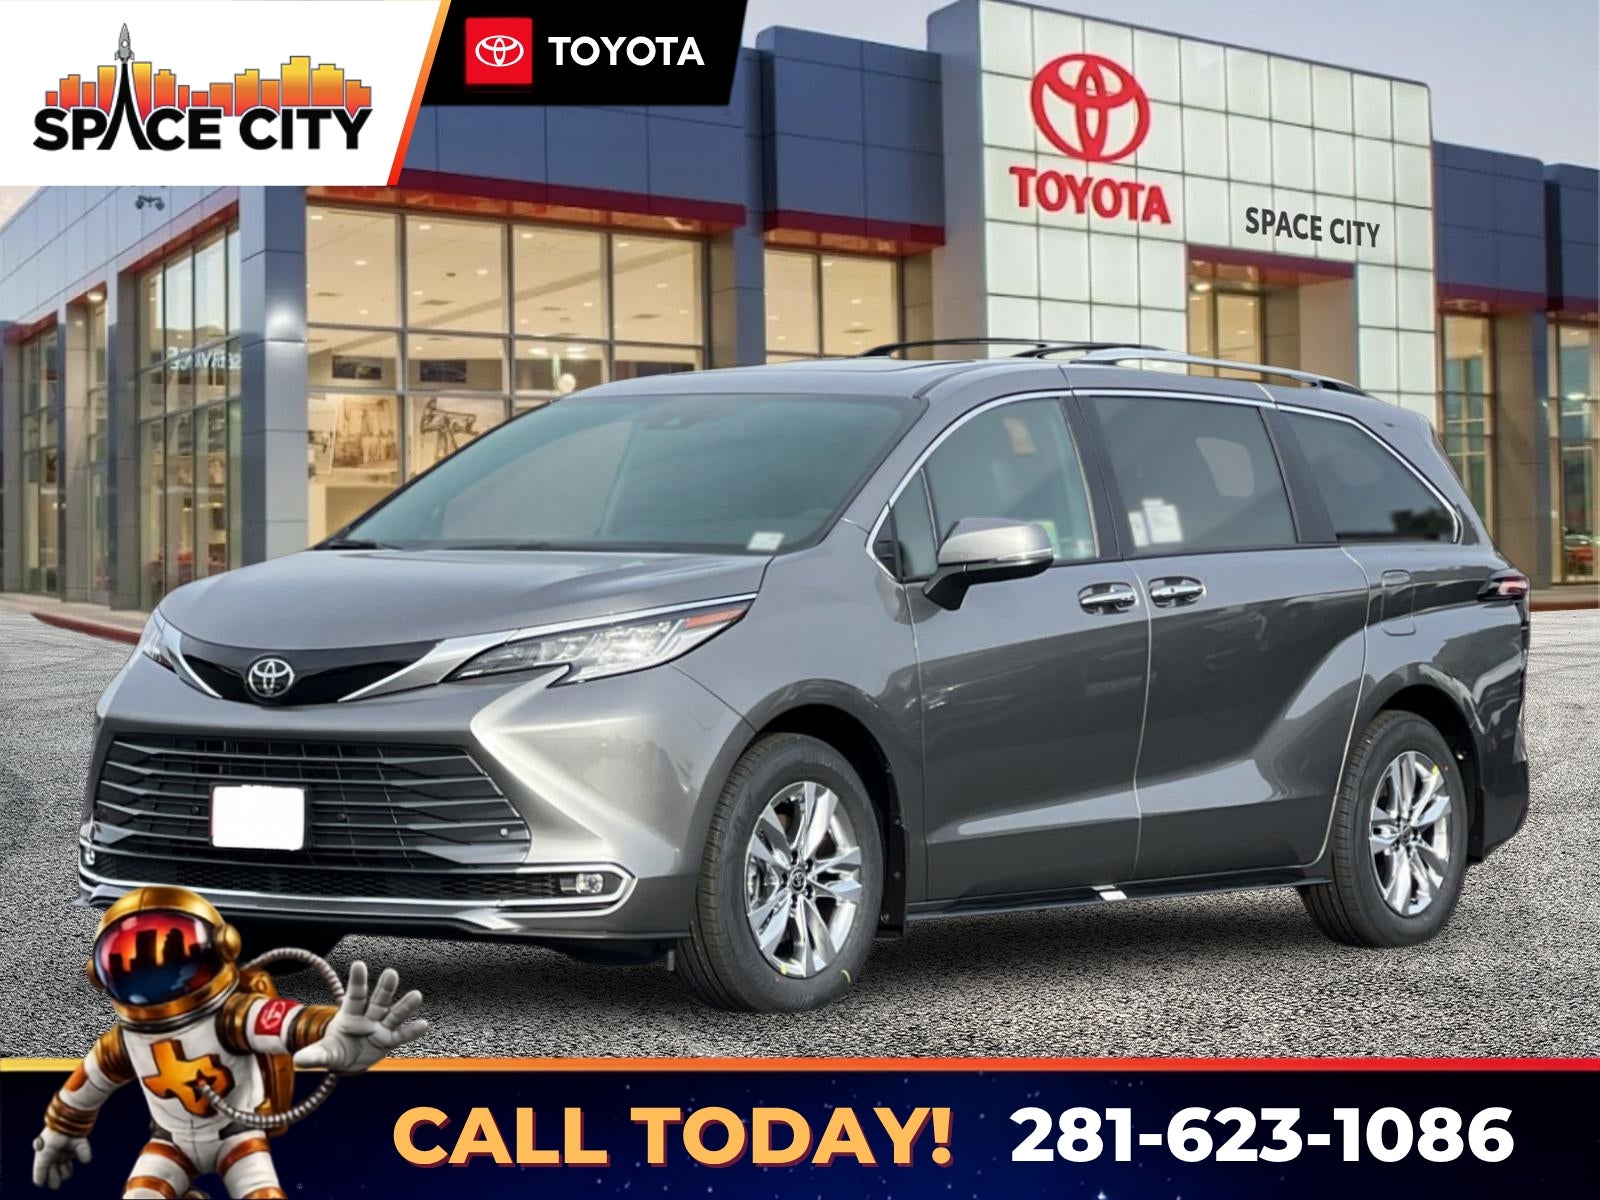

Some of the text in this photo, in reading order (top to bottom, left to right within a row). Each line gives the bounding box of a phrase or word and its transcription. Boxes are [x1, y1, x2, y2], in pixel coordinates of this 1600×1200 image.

[1009, 166, 1171, 224] TOYOTA
[1245, 207, 1380, 248] SPACE CITY
